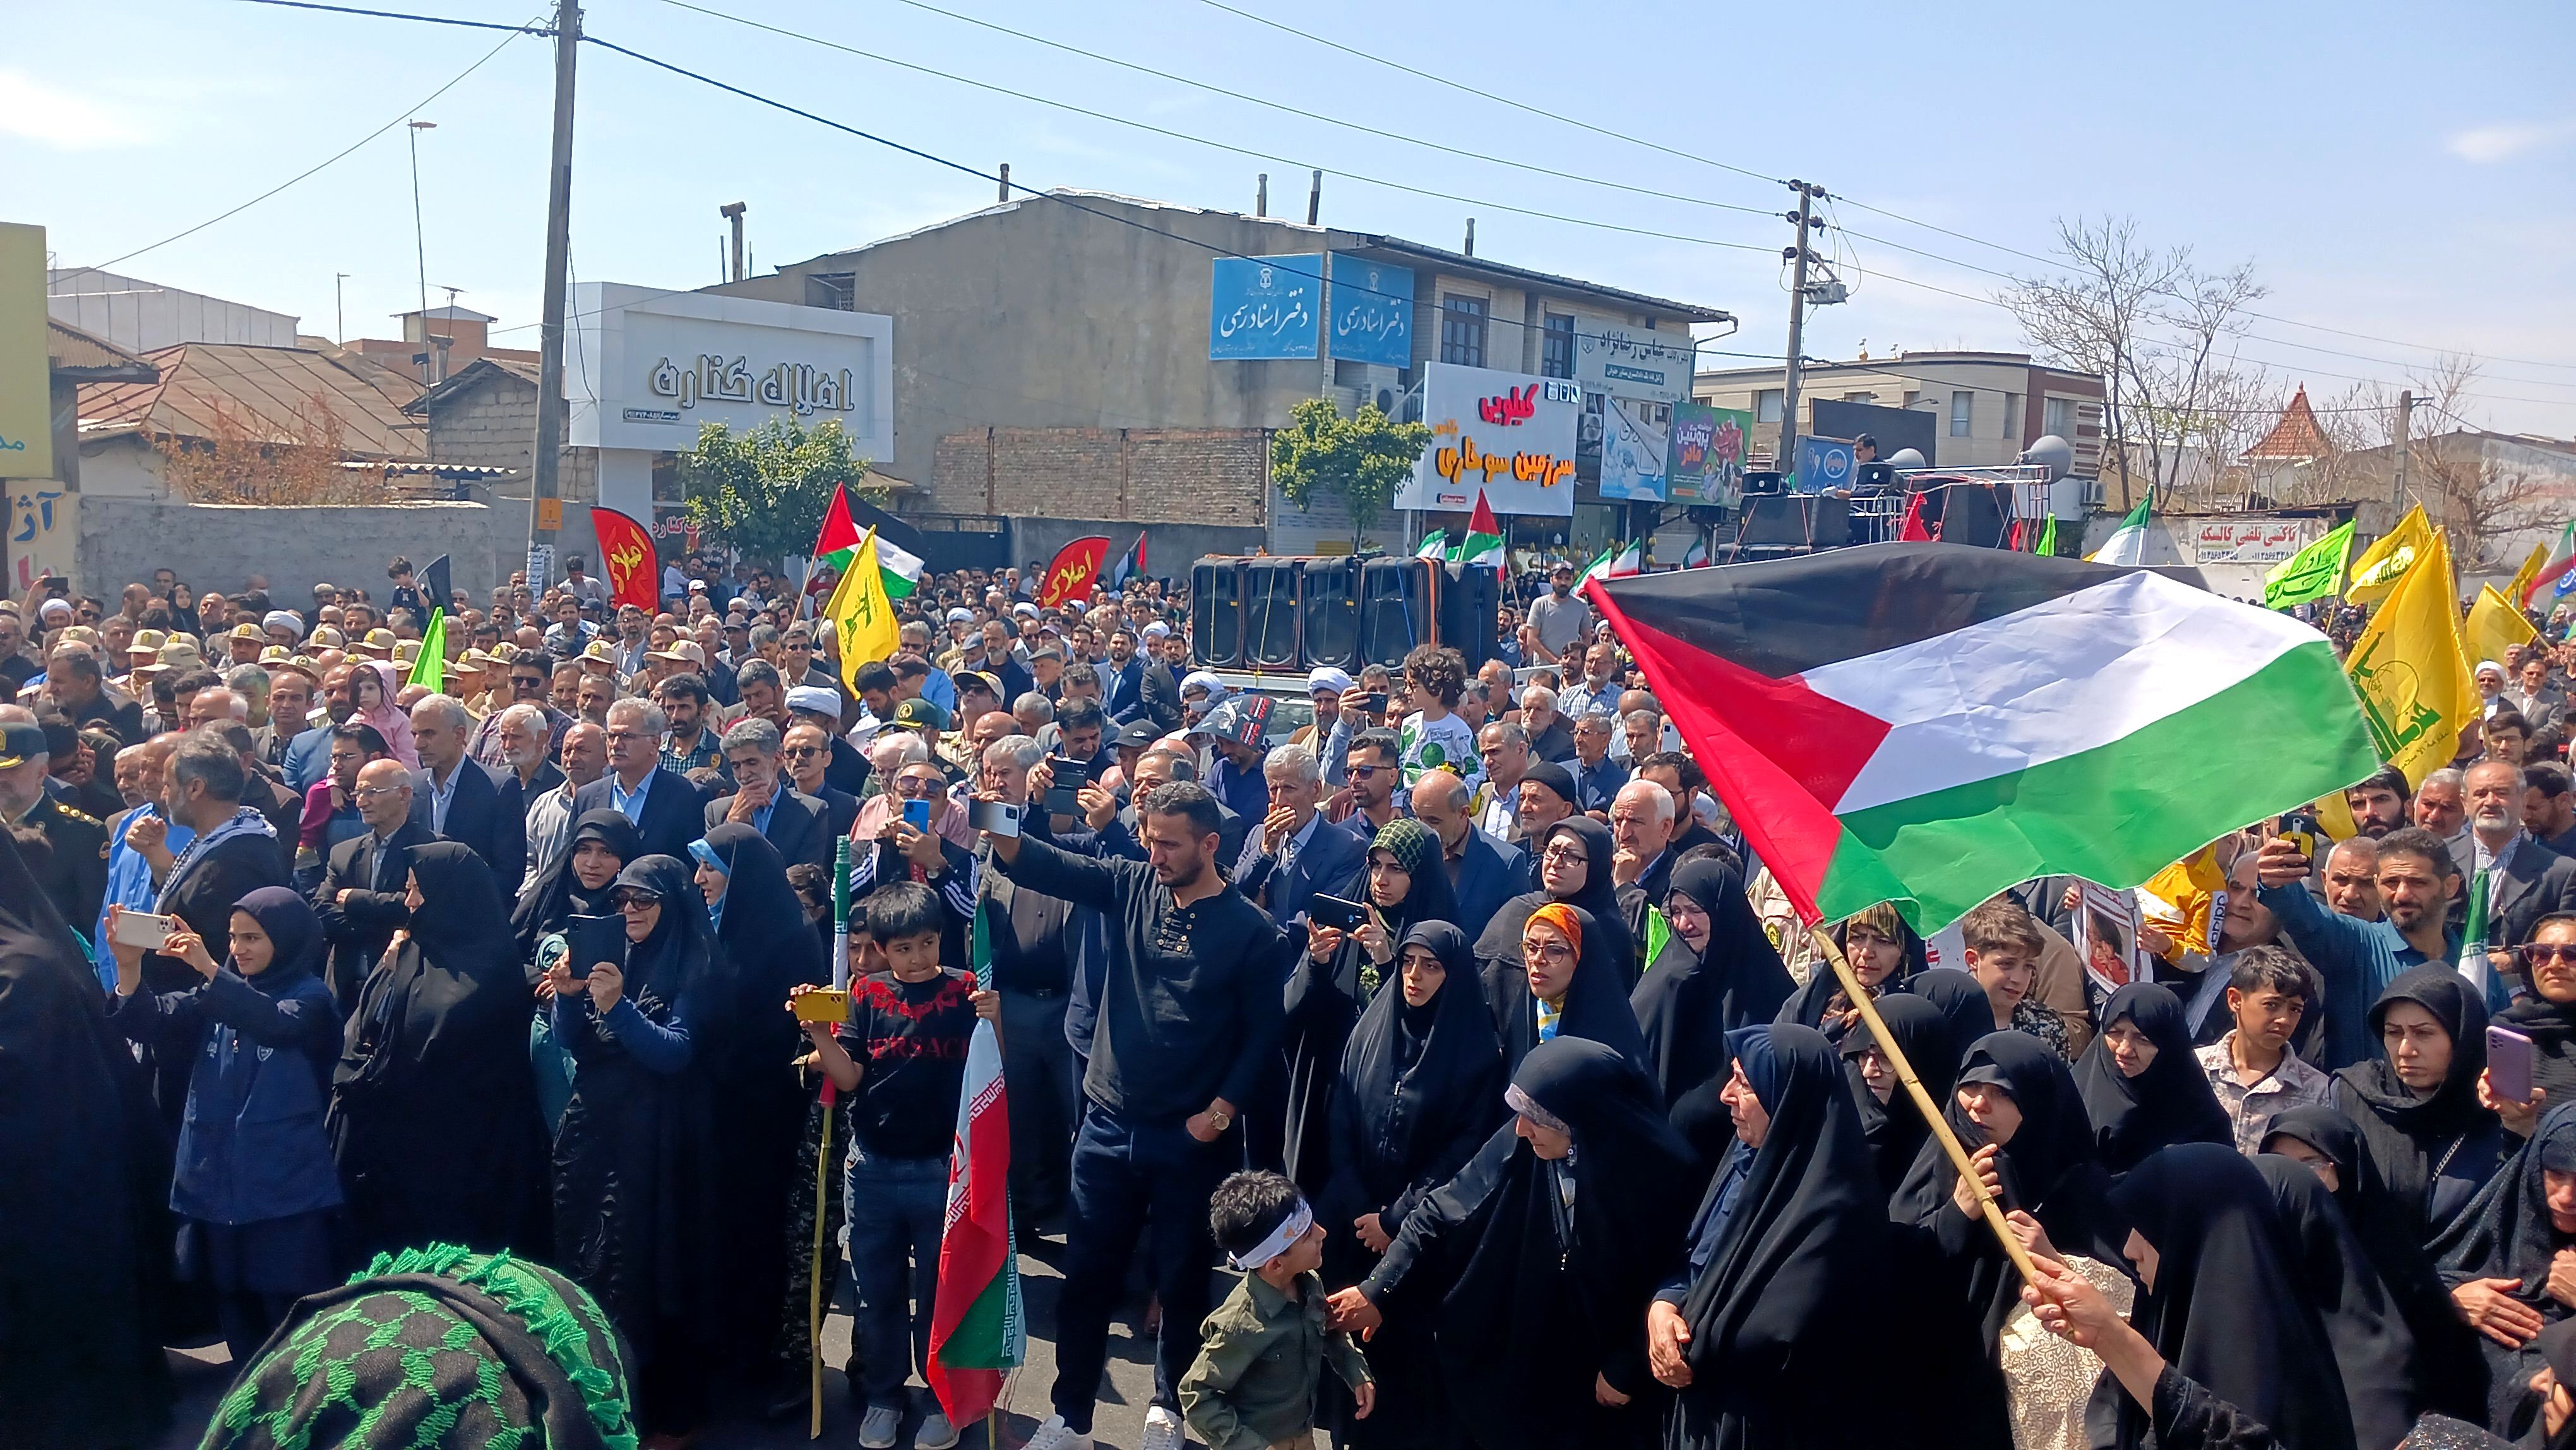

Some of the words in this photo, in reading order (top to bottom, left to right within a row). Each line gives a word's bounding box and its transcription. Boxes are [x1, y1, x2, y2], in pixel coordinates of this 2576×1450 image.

[1220, 302, 1250, 338] رسمی
[1248, 303, 1279, 329] اسناد
[1273, 287, 1308, 337] دفتر
[1337, 304, 1361, 337] رسمی
[1378, 299, 1404, 342] دفتر
[650, 353, 755, 409] کناره
[759, 362, 856, 416] املاک
[1478, 383, 1539, 427] کیلویی
[1434, 435, 1510, 484] سوخاری
[1512, 450, 1574, 488] سرزمین
[652, 515, 686, 538] کناره
[2200, 525, 2234, 542] کالسکه
[2235, 525, 2262, 548] تلفنی
[2263, 524, 2296, 548] تاکسی
